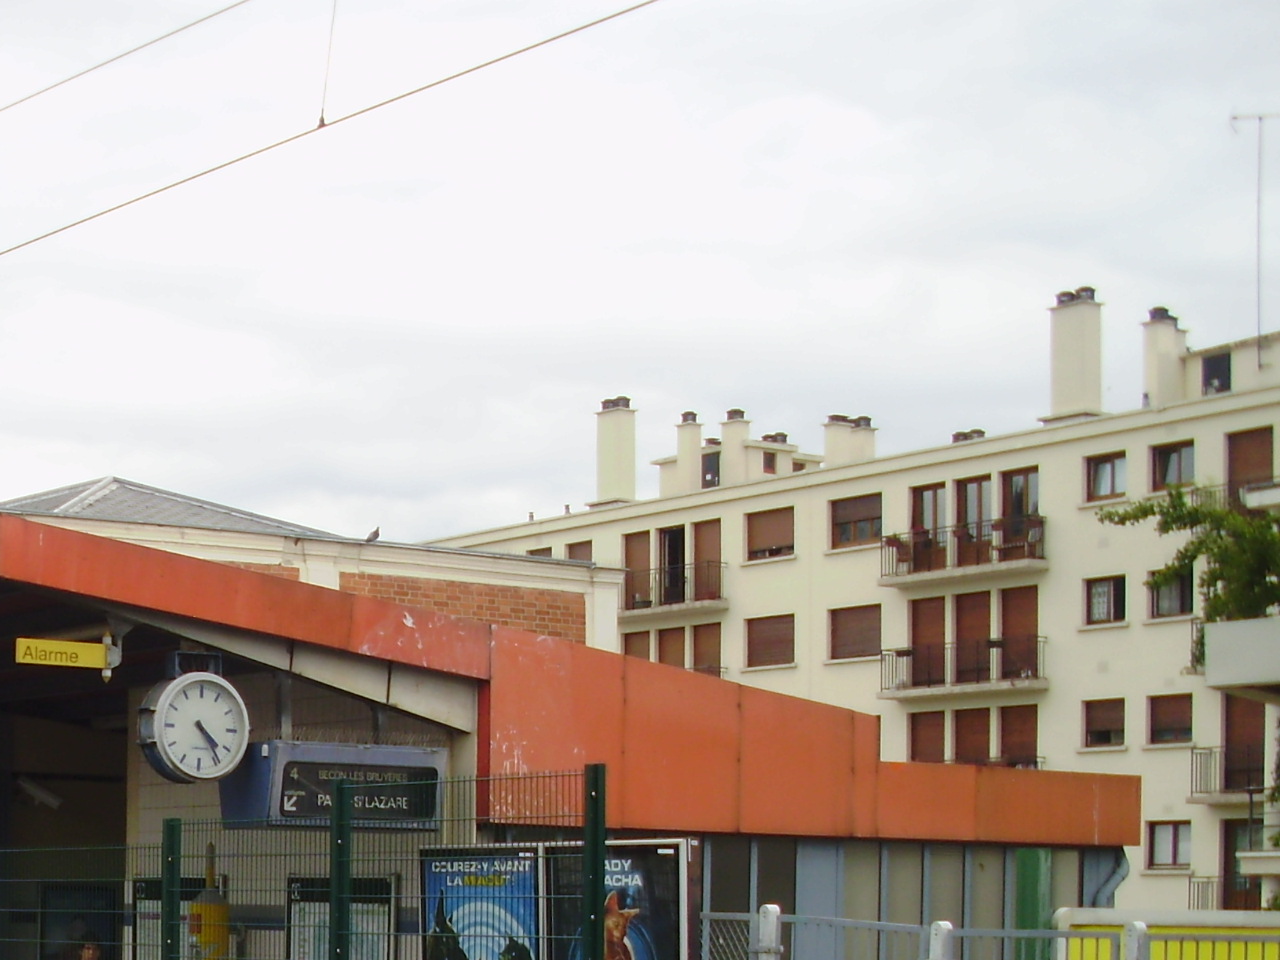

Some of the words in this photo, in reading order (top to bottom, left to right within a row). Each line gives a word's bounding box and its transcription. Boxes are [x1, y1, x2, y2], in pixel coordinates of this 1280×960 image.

[22, 645, 79, 664] Alarme
[289, 767, 299, 780] 4
[349, 771, 364, 781] LES
[365, 797, 408, 809] LAZARE
[492, 860, 531, 872] AVANT
[604, 859, 632, 872] ADY
[446, 876, 463, 887] LA
[604, 874, 643, 887] ACHA
